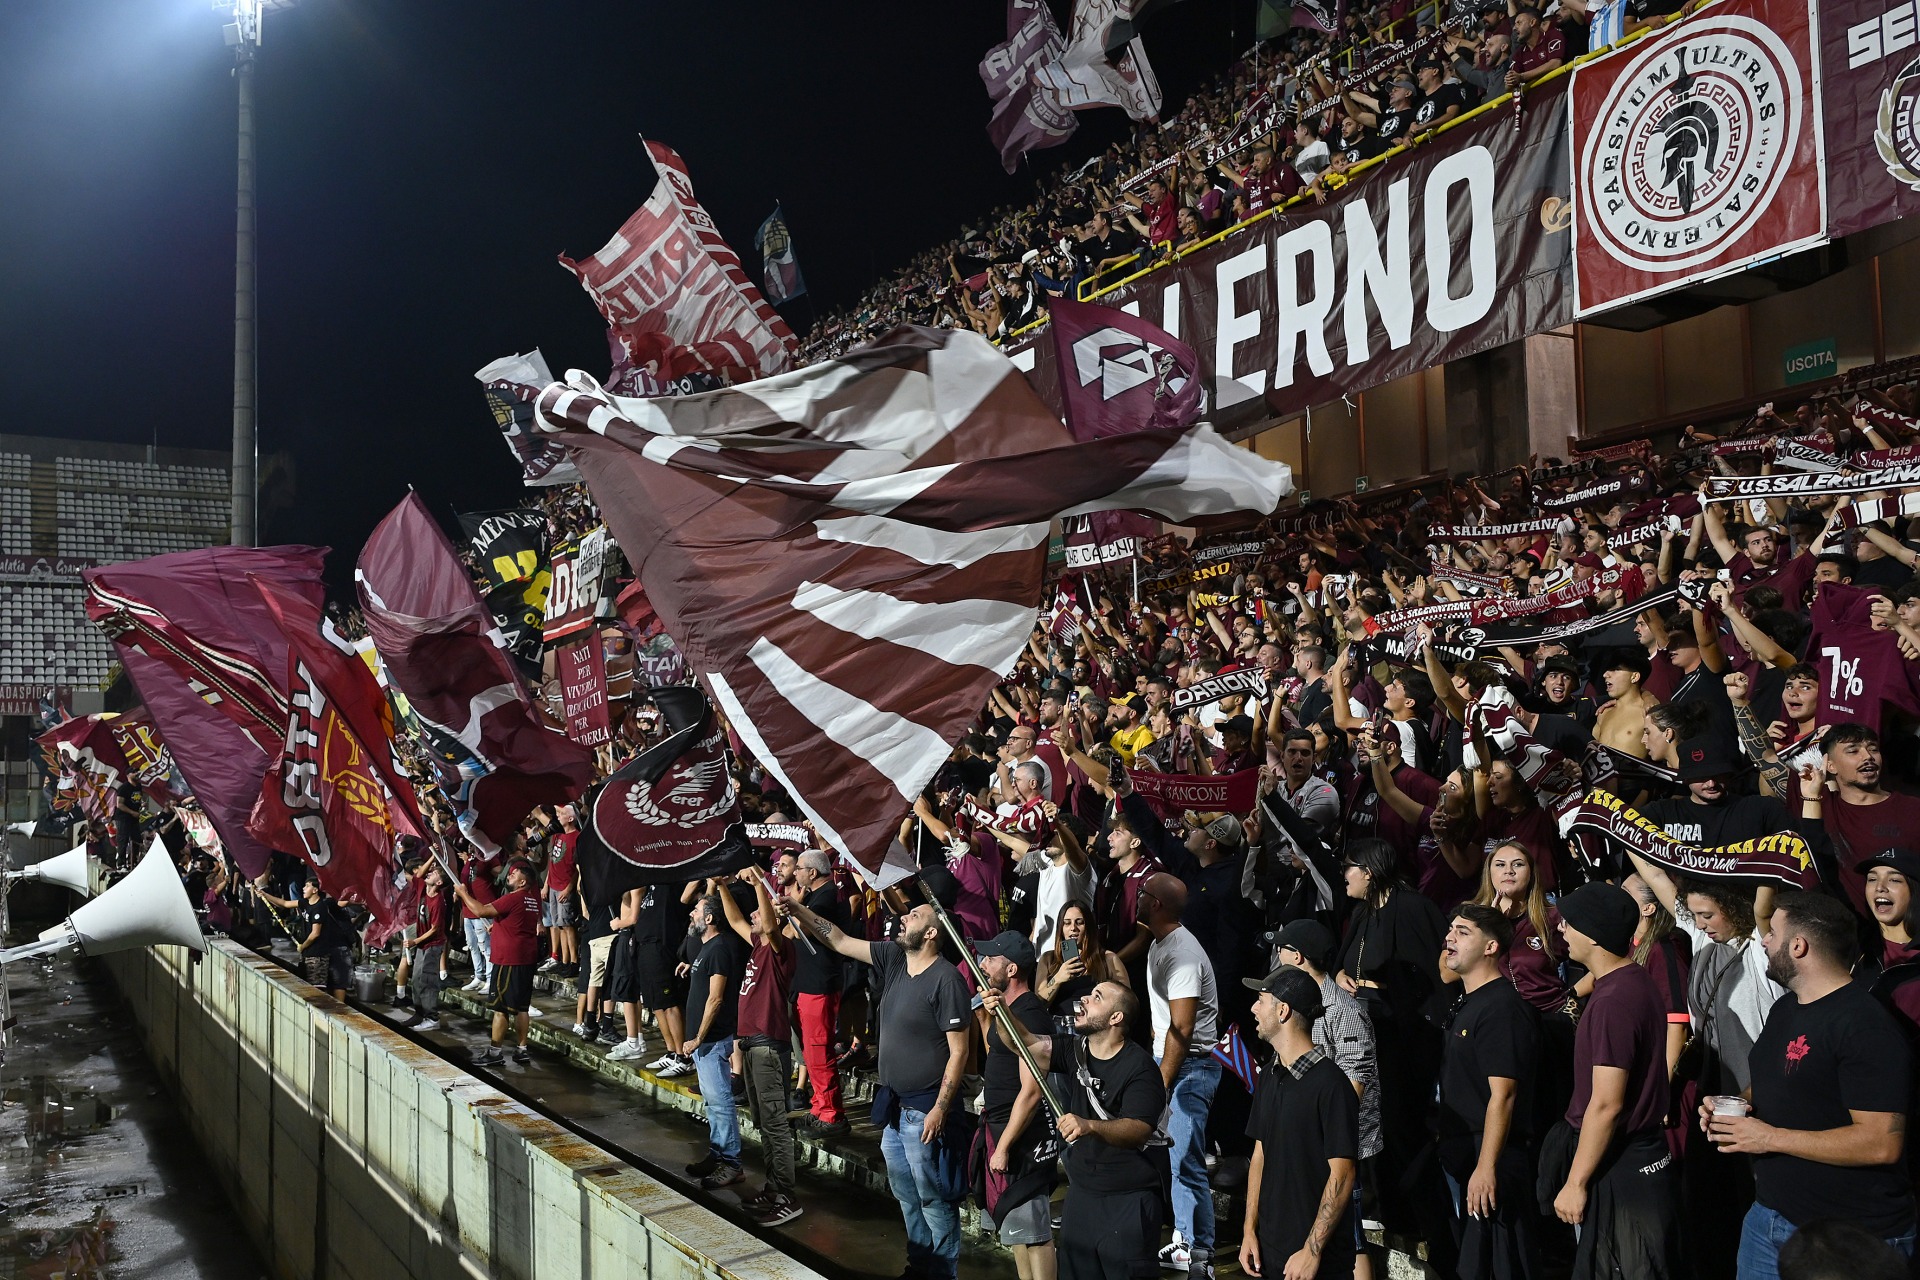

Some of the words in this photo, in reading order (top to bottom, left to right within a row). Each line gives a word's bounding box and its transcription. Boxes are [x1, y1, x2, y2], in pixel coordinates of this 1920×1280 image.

[1848, 0, 1920, 69] SE
[1602, 63, 1672, 217] PAESTUM
[1691, 45, 1777, 122] ULTRAS
[1755, 126, 1771, 169] 1919
[1624, 171, 1760, 250] SALERNO
[1786, 350, 1835, 374] USCITA
[1885, 457, 1911, 468] Secolo
[1888, 445, 1913, 457] 1919
[1597, 480, 1622, 494] 1919
[1452, 517, 1562, 537] SALERNITANA
[1607, 522, 1663, 550] SALERN
[1145, 562, 1231, 593] SALERNO
[571, 646, 592, 665] NATI
[577, 664, 592, 680] PER
[1821, 646, 1864, 701] 7%
[566, 676, 598, 699] VIVERLA
[0, 701, 34, 714] ANATA
[574, 716, 589, 731] PER
[1165, 786, 1228, 801] BANCONE
[1608, 809, 1644, 846] Curva
[1645, 831, 1672, 860] Sud
[1675, 844, 1740, 872] Siberiano
